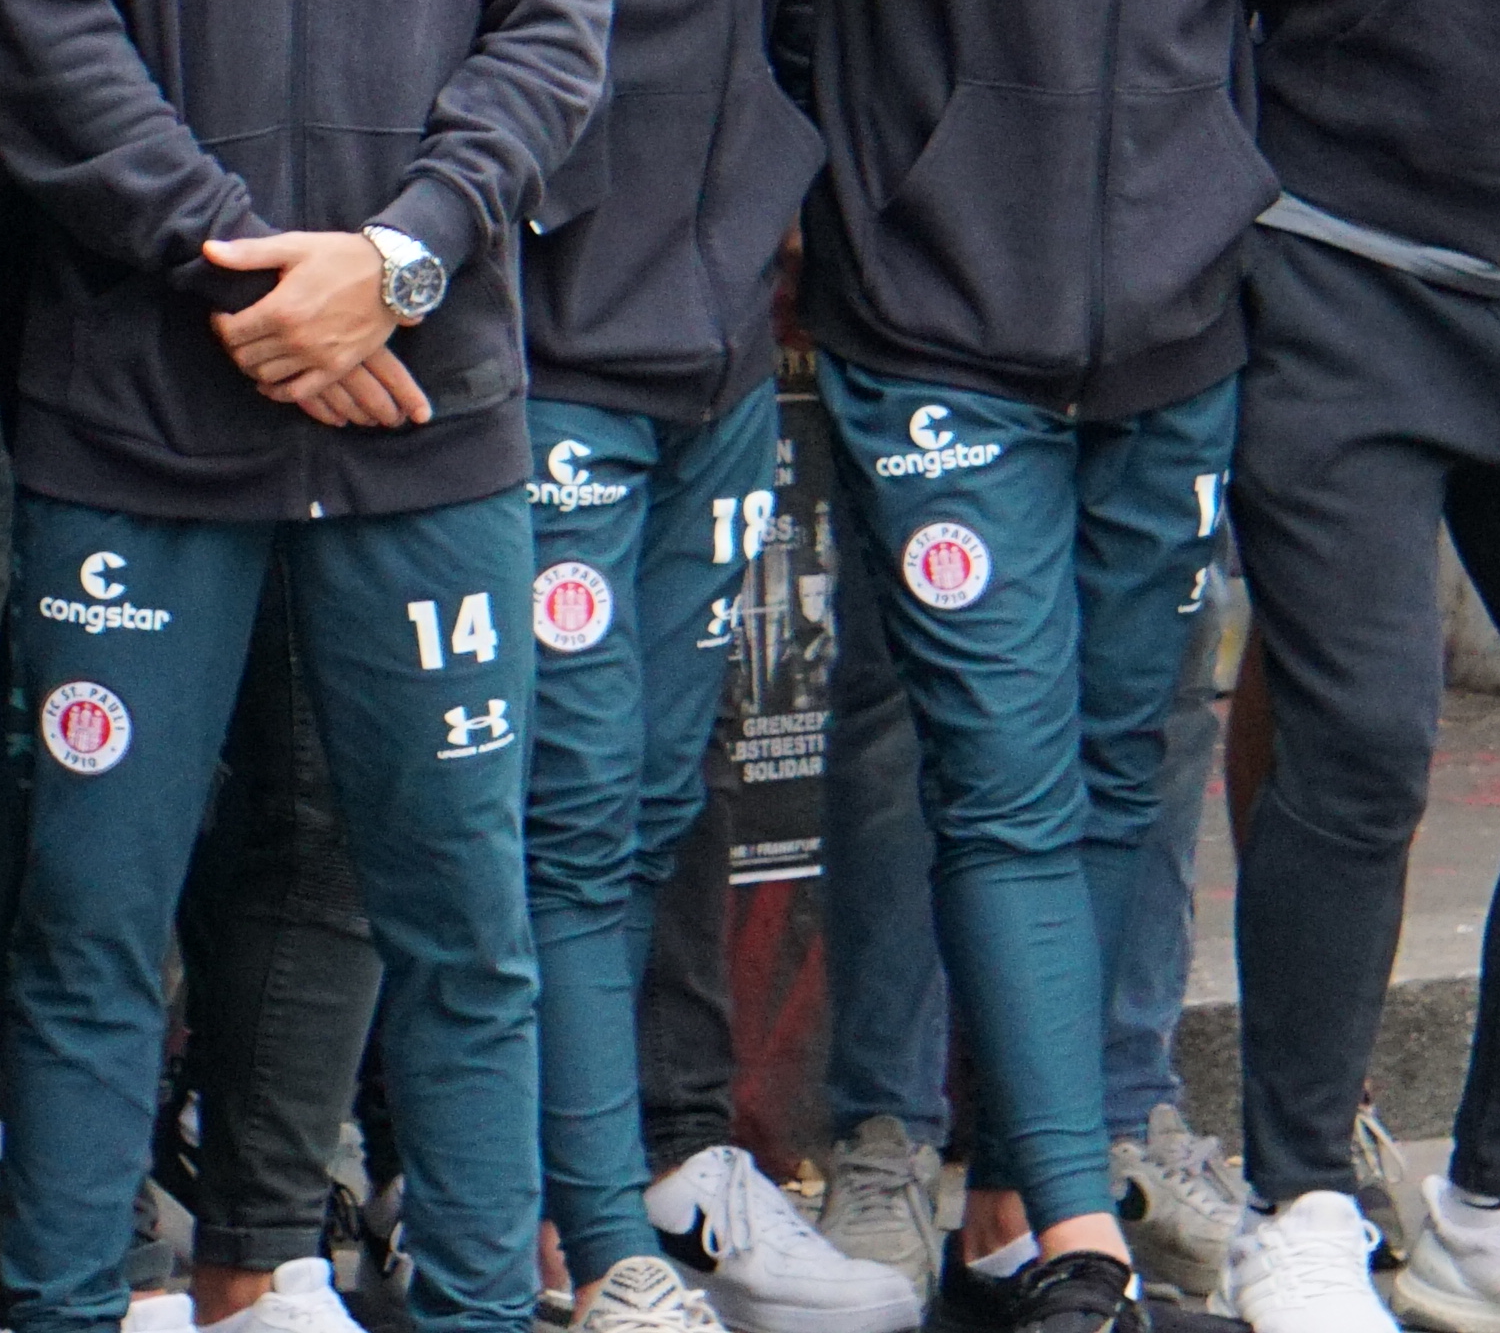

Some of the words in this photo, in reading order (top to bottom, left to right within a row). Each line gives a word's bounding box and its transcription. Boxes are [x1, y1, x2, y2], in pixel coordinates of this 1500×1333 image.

[875, 443, 1001, 479] congstar
[39, 596, 170, 635] congstar
[933, 592, 968, 605] 1910
[407, 591, 498, 671] 14
[48, 699, 61, 719] FC
[89, 686, 125, 733] PAULI
[64, 751, 97, 769] 1910
